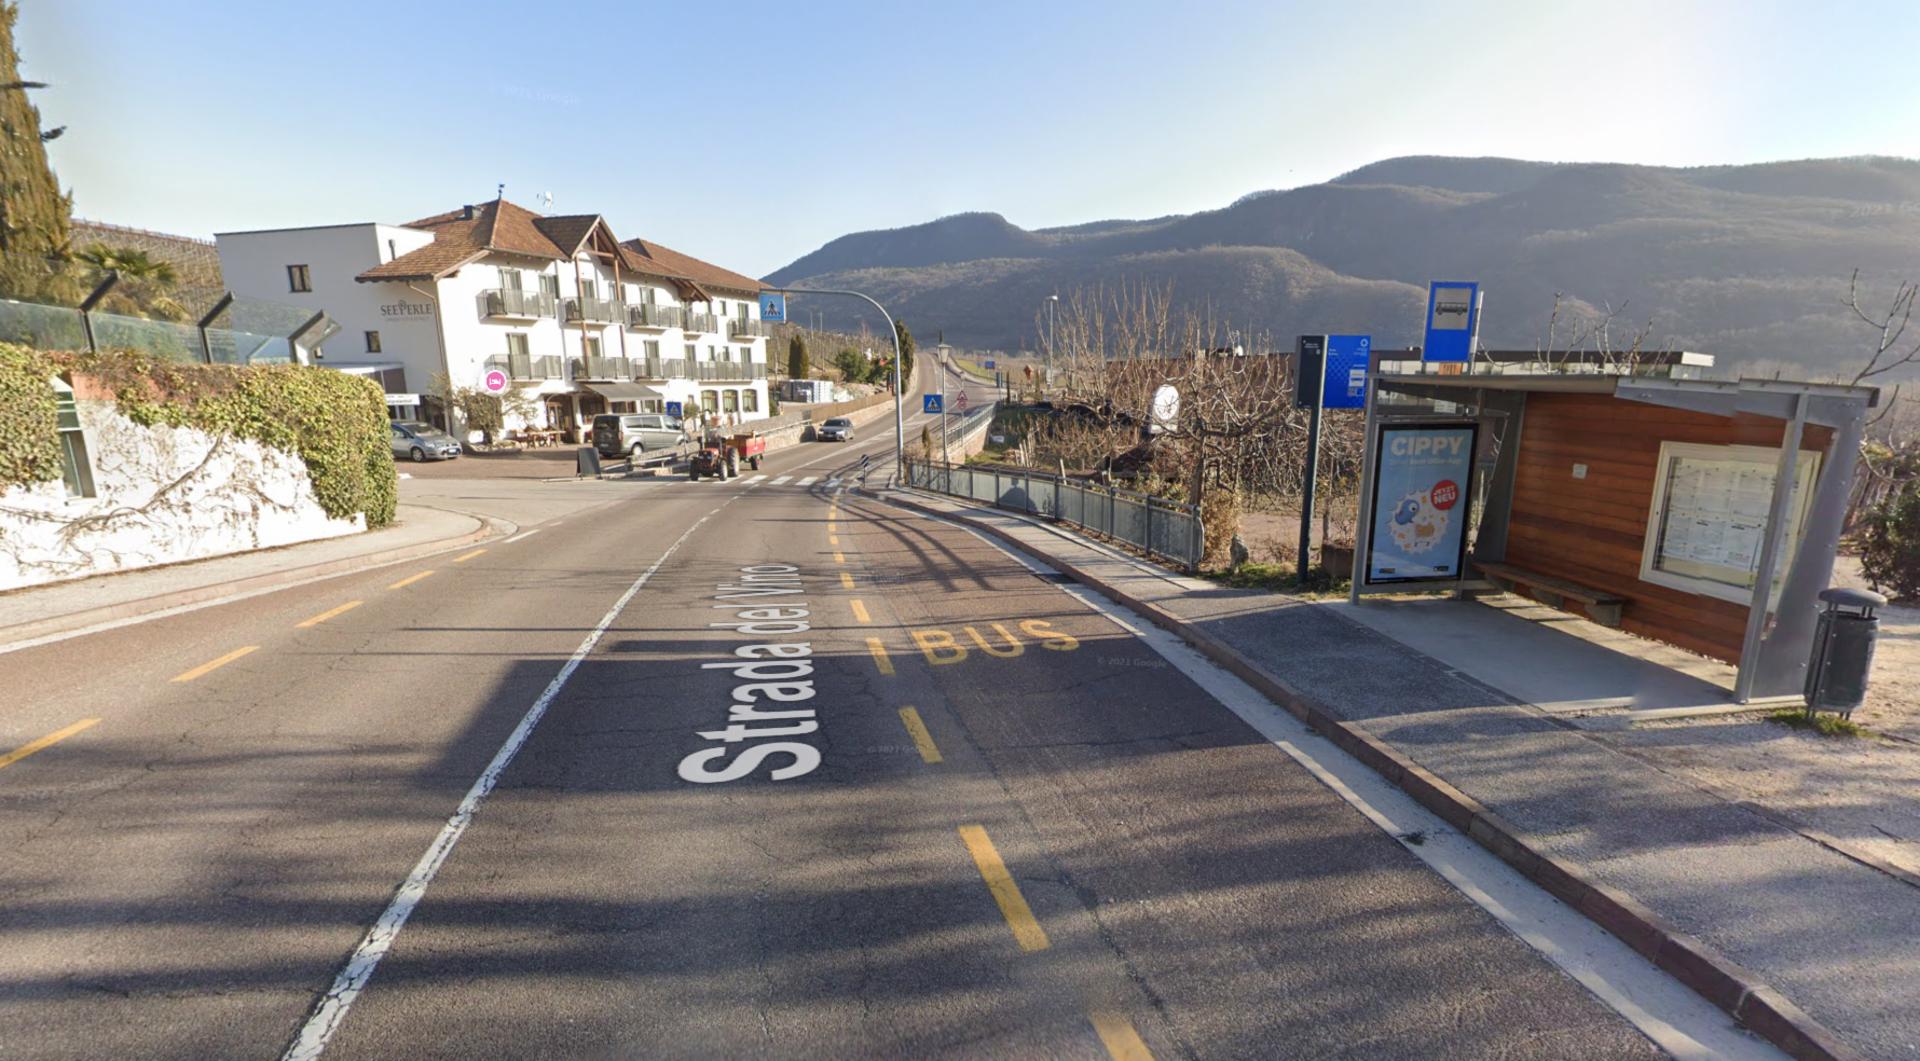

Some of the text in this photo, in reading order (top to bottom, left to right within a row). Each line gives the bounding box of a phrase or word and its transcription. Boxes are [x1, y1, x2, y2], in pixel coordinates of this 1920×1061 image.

[380, 302, 432, 315] SEEPERLE
[1391, 436, 1464, 456] CIPPY
[1433, 491, 1456, 504] NEU
[911, 619, 1080, 665] BUS
